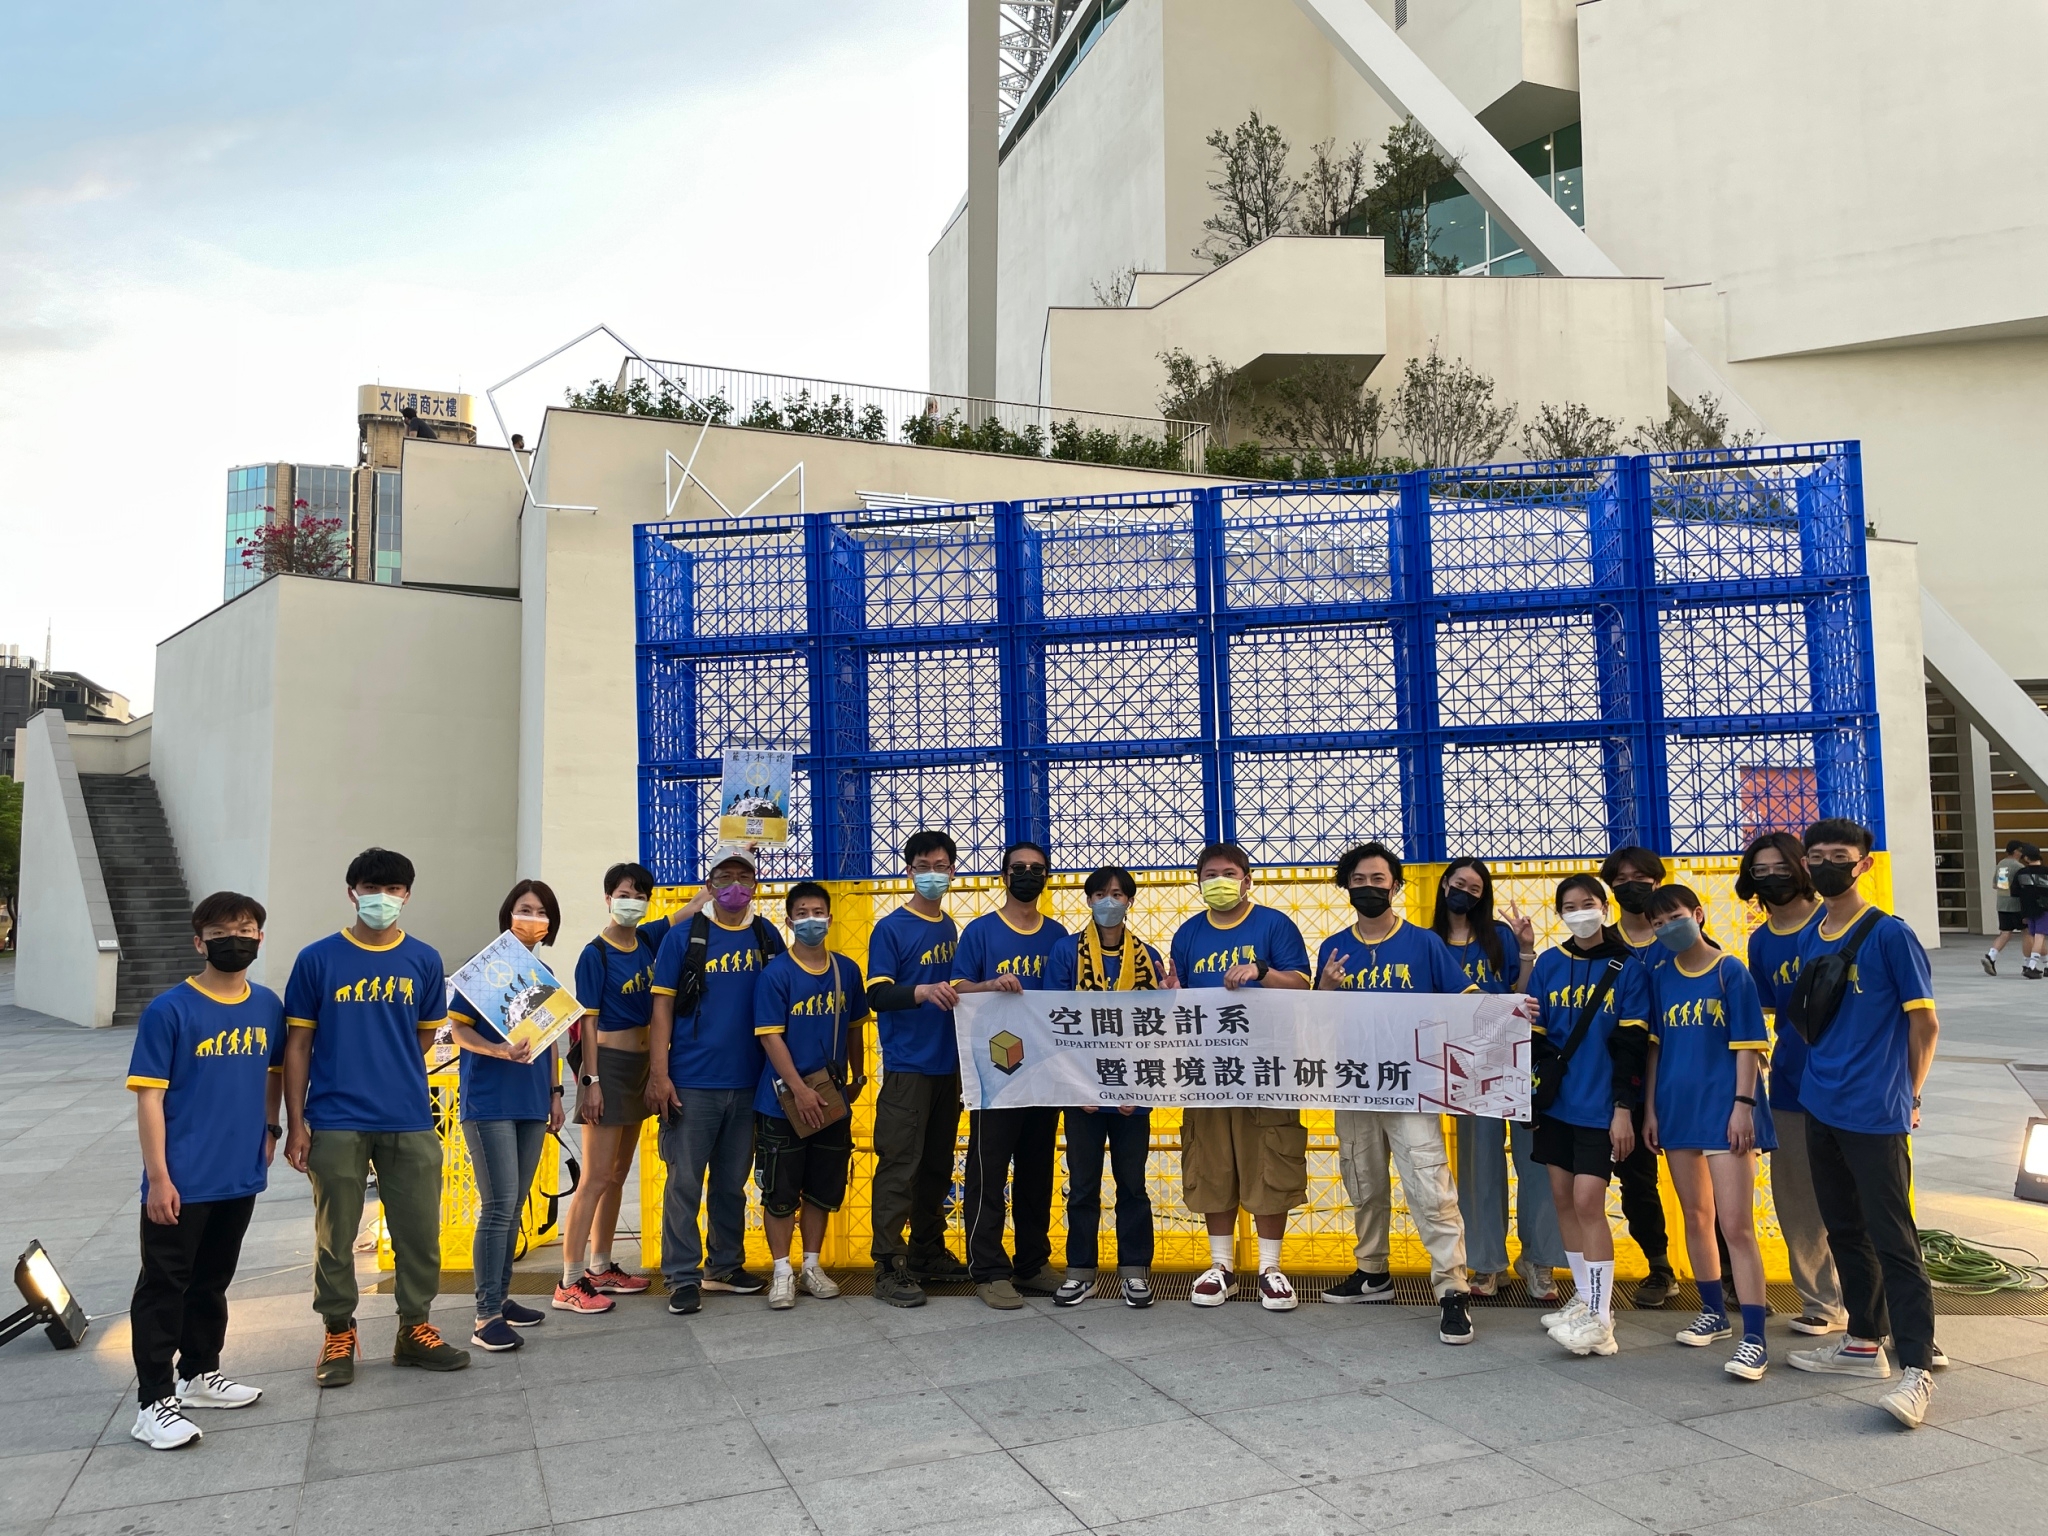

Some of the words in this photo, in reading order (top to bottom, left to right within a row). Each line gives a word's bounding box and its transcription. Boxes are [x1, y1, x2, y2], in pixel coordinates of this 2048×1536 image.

[380, 391, 457, 417] 文化通商大樓
[1049, 1003, 1250, 1037] 空間設計系
[1055, 1038, 1133, 1050] DEPARTMENT
[1135, 1040, 1151, 1049] OF
[1153, 1038, 1202, 1049] SPATIAL
[1204, 1037, 1249, 1048] DESIGN
[1096, 1055, 1412, 1091] 暨環境設計研究所
[1099, 1091, 1177, 1102] GRANDUATE
[1179, 1092, 1234, 1102] SCHOOL
[1236, 1091, 1254, 1101] OF
[1257, 1093, 1361, 1105] ENVIRONMENT
[1363, 1095, 1415, 1106] DESIGN
